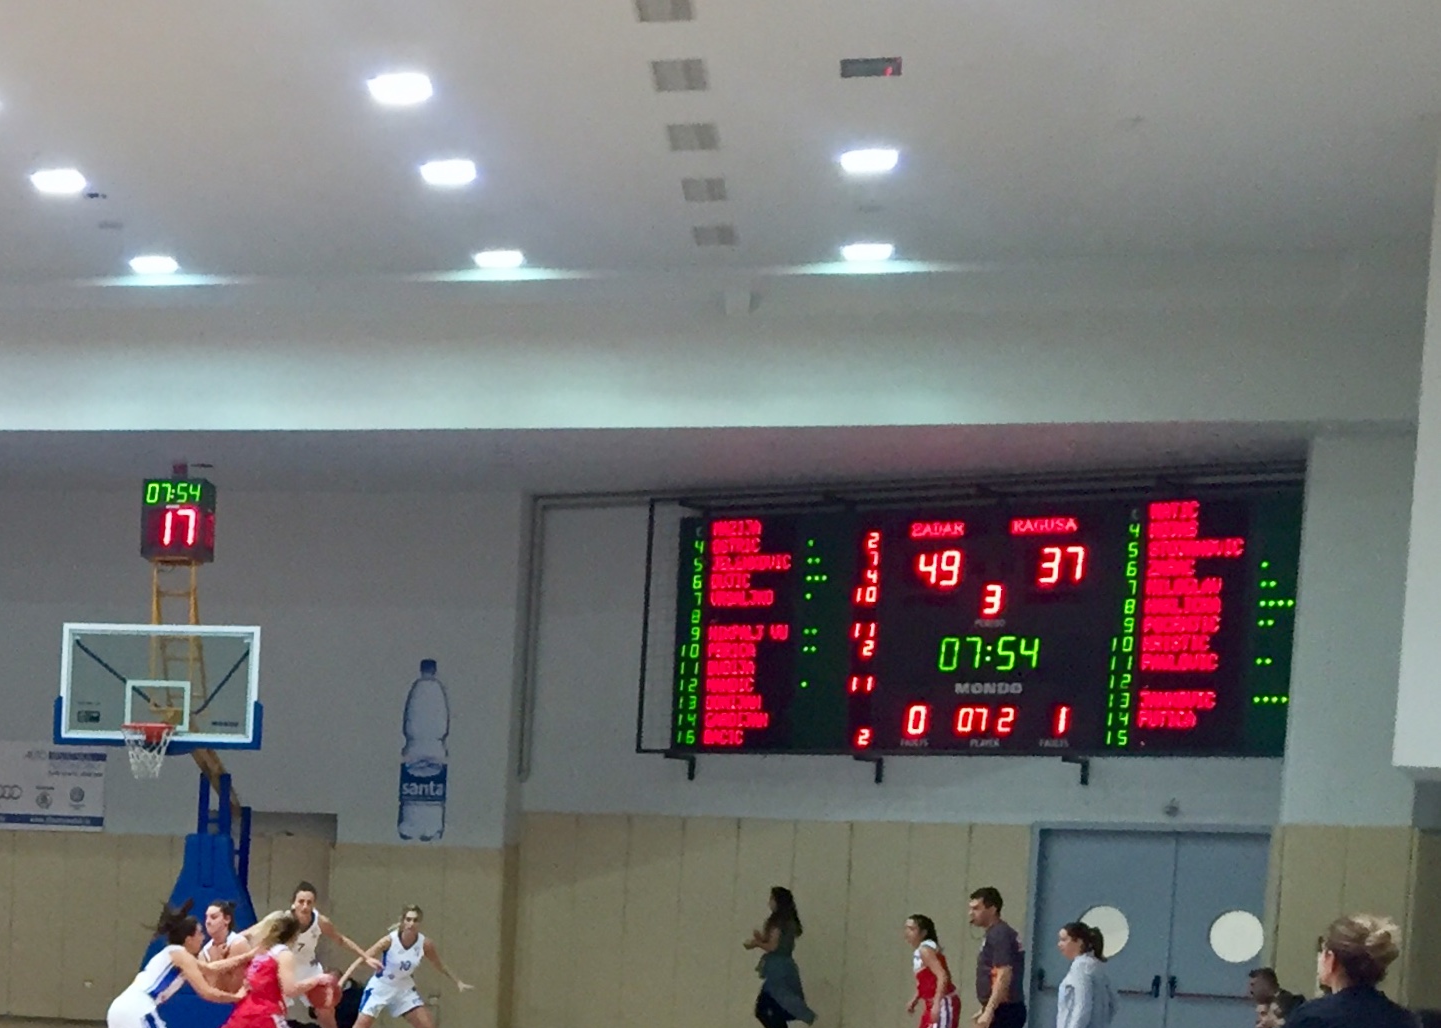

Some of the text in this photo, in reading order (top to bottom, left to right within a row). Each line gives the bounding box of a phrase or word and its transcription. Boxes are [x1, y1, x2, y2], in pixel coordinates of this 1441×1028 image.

[146, 483, 201, 503] 07:54
[163, 508, 196, 546] 17
[1012, 518, 1078, 535] RAGUSA
[1129, 523, 1141, 538] 4
[694, 541, 704, 553] 4
[868, 532, 879, 548] 2
[1128, 541, 1138, 558] 5
[694, 558, 703, 572] 5
[870, 551, 878, 566] 7
[918, 550, 961, 586] 49
[1038, 546, 1085, 583] 37
[1125, 559, 1137, 577] 6
[692, 575, 702, 590] 6
[867, 569, 878, 584] 4
[1127, 578, 1137, 595] 7
[693, 592, 702, 606] 7
[856, 586, 877, 603] 10
[983, 584, 1001, 614] 3
[1123, 598, 1136, 615] 8
[691, 609, 701, 624] 8
[1123, 616, 1135, 634] 9
[691, 626, 701, 641] 9
[854, 623, 876, 639] 11
[681, 643, 700, 659] 10
[862, 640, 875, 657] 2
[1111, 635, 1134, 653] 10
[939, 636, 1040, 671] 07:54
[680, 661, 699, 675] 11
[1110, 655, 1134, 671] 11
[680, 678, 698, 692] 12
[851, 676, 873, 692] 11
[954, 682, 1023, 694] MONDO
[1109, 673, 1132, 690] 12
[679, 695, 697, 710] 13
[1108, 692, 1130, 709] 13
[678, 713, 696, 726] 14
[907, 705, 927, 735] 0
[1057, 705, 1070, 734] 1
[1107, 711, 1129, 727] 14
[677, 730, 696, 744] 16
[857, 728, 871, 745] 2
[1105, 729, 1128, 747] 15
[402, 781, 444, 796] santa
[298, 943, 305, 952] 7
